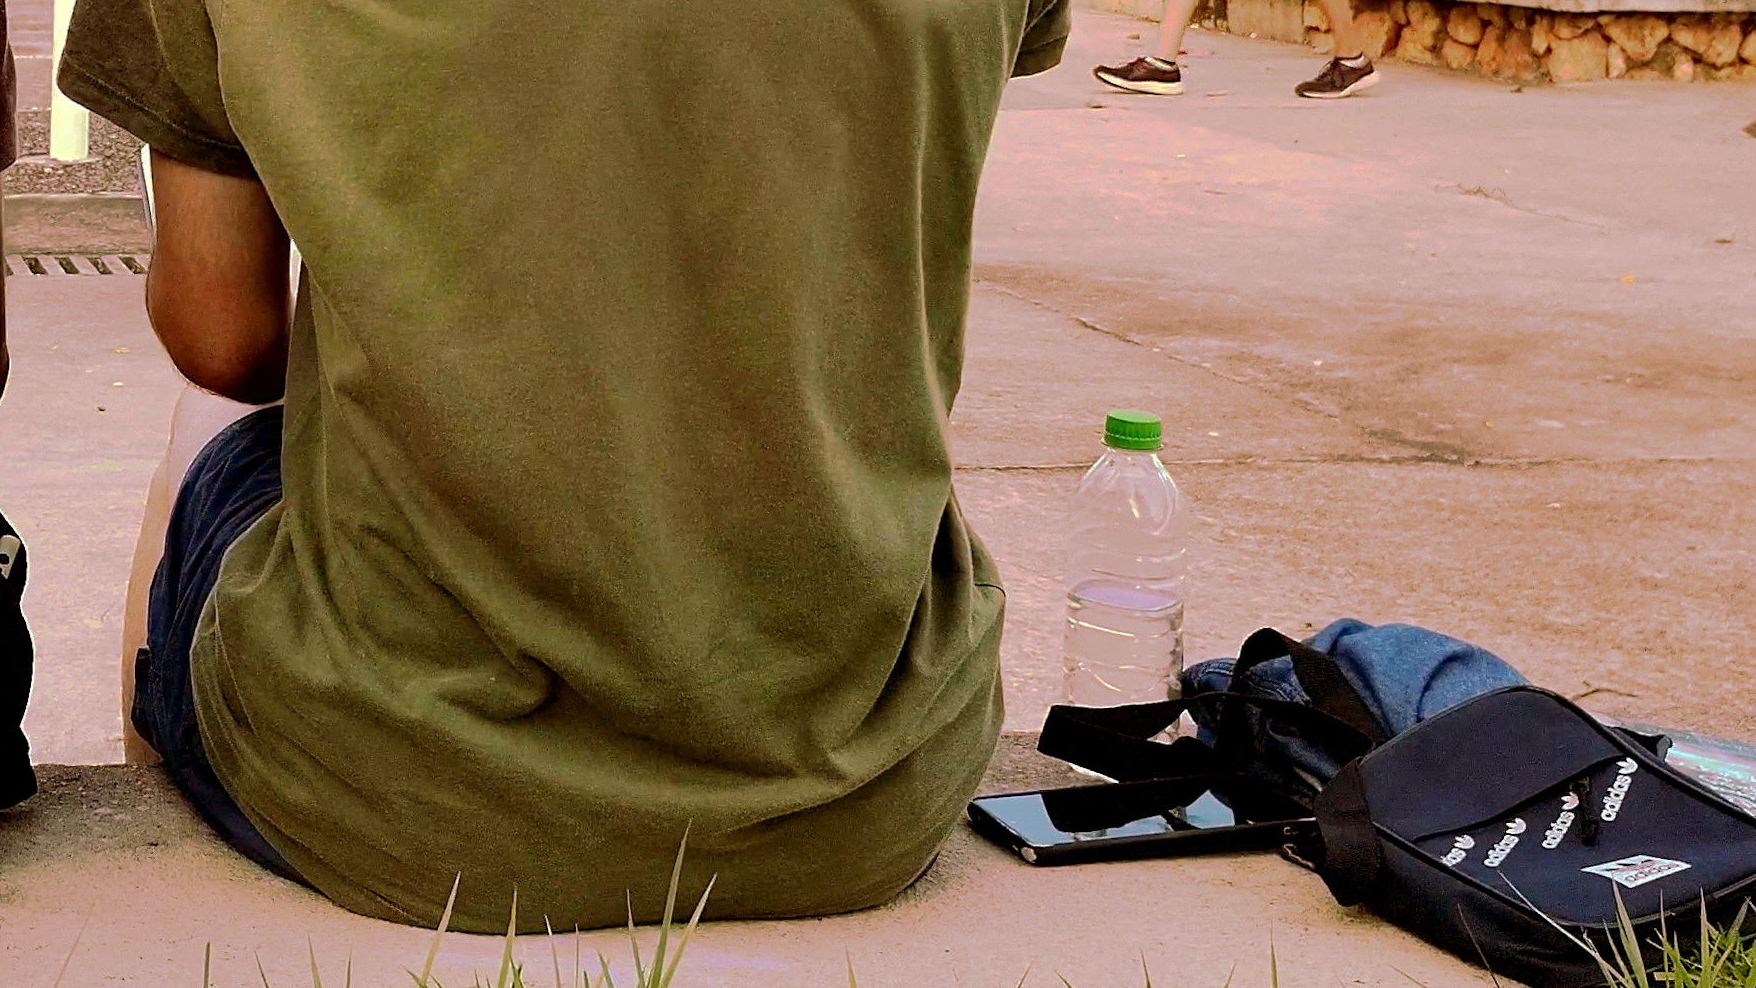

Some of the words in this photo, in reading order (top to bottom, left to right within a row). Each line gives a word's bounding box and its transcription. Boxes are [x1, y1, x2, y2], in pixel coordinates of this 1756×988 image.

[1601, 775, 1632, 821] adidas
[1542, 811, 1575, 849] adidas
[1483, 834, 1520, 867] adidas
